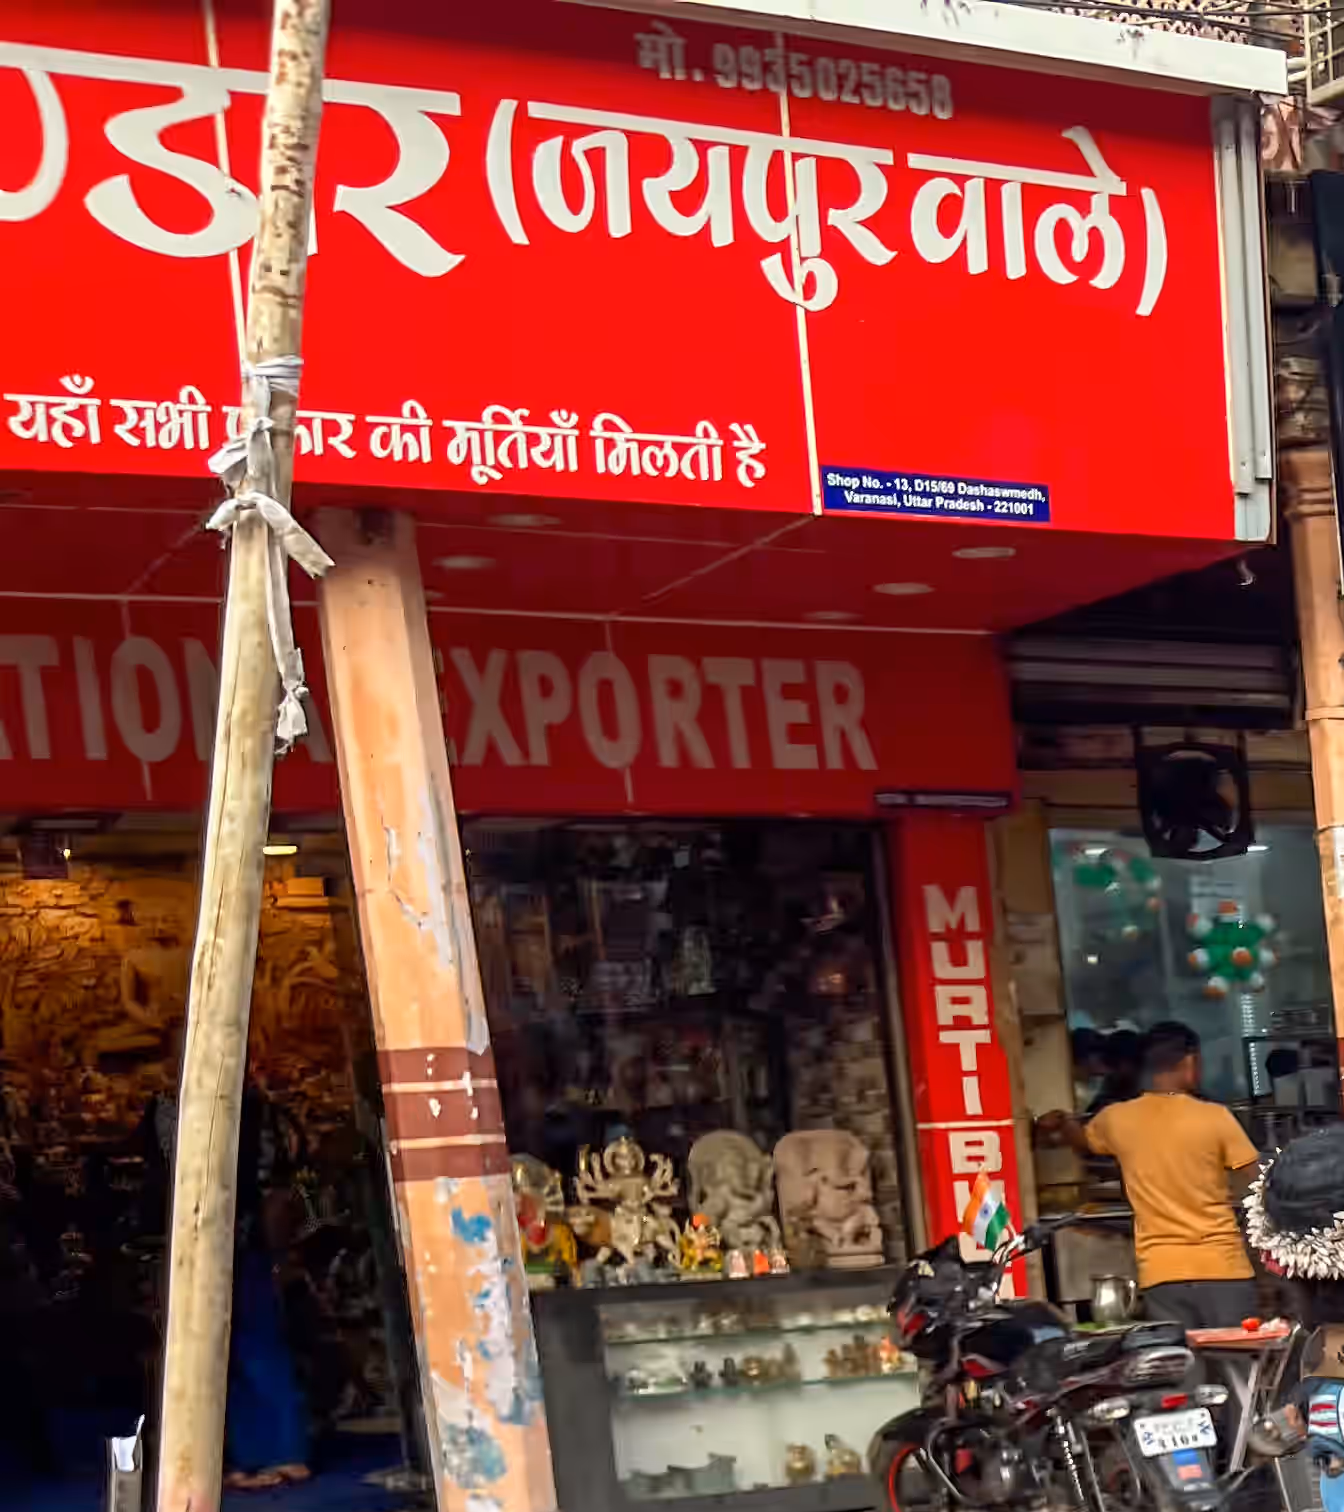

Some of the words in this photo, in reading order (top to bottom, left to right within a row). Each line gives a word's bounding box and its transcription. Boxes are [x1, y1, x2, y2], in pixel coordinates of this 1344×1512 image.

[907, 126, 1168, 317] वाले)
[3, 374, 101, 448] यहाँ
[110, 385, 211, 450] सभी
[365, 399, 433, 463] की
[442, 404, 579, 485] मूर्तियाँ
[590, 412, 723, 482] मिलती
[730, 423, 766, 487] है
[827, 473, 860, 489] Shop
[862, 474, 883, 489] No.
[894, 478, 912, 493] 13,
[844, 490, 901, 508] Varanasi,
[903, 494, 933, 508] Uttar
[935, 496, 984, 512] Pradesh
[994, 502, 1034, 515] 221001
[434, 645, 877, 771] XPORTER
